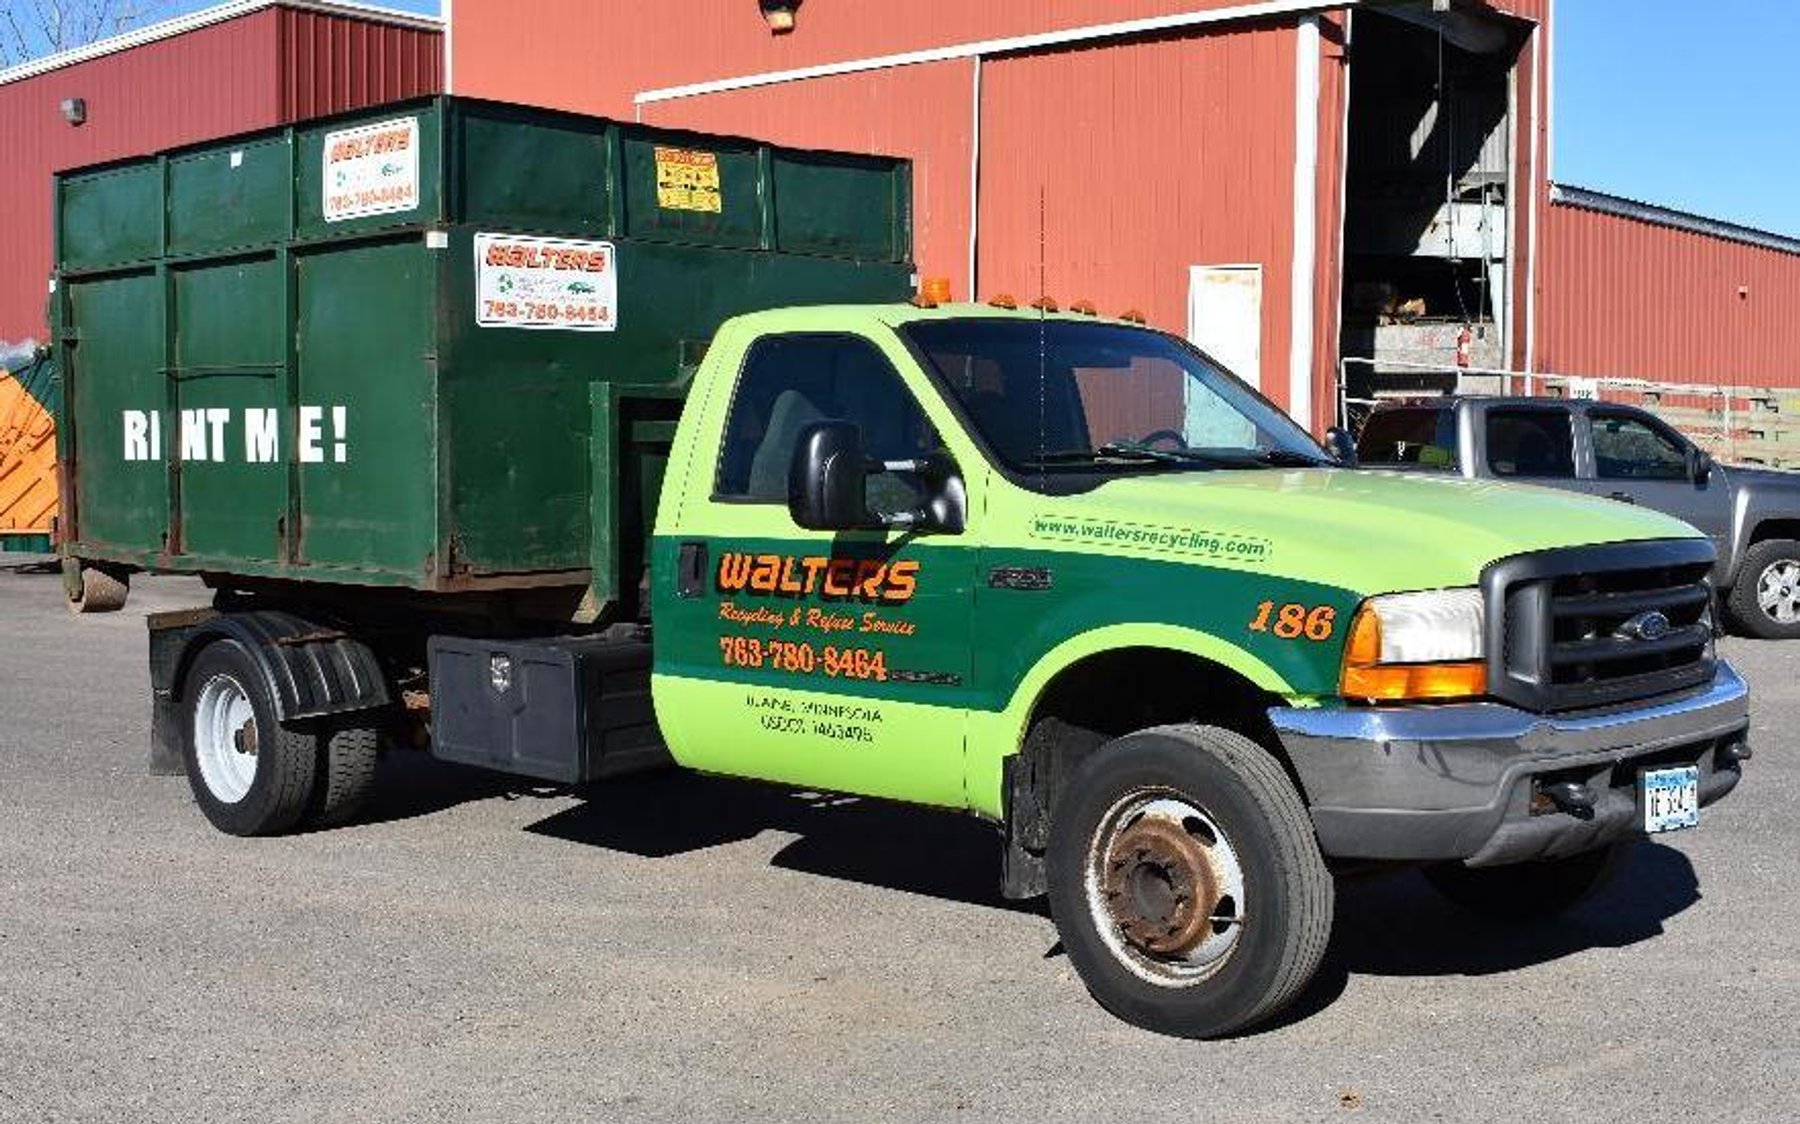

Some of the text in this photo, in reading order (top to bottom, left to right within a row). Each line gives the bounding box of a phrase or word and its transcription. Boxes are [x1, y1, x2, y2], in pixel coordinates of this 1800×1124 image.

[1034, 518, 1265, 557] www.waltersrecycling.com
[718, 601, 917, 636] Recycling & Refuse Service
[1248, 599, 1336, 642] 186
[719, 636, 888, 682] 763-780-8464
